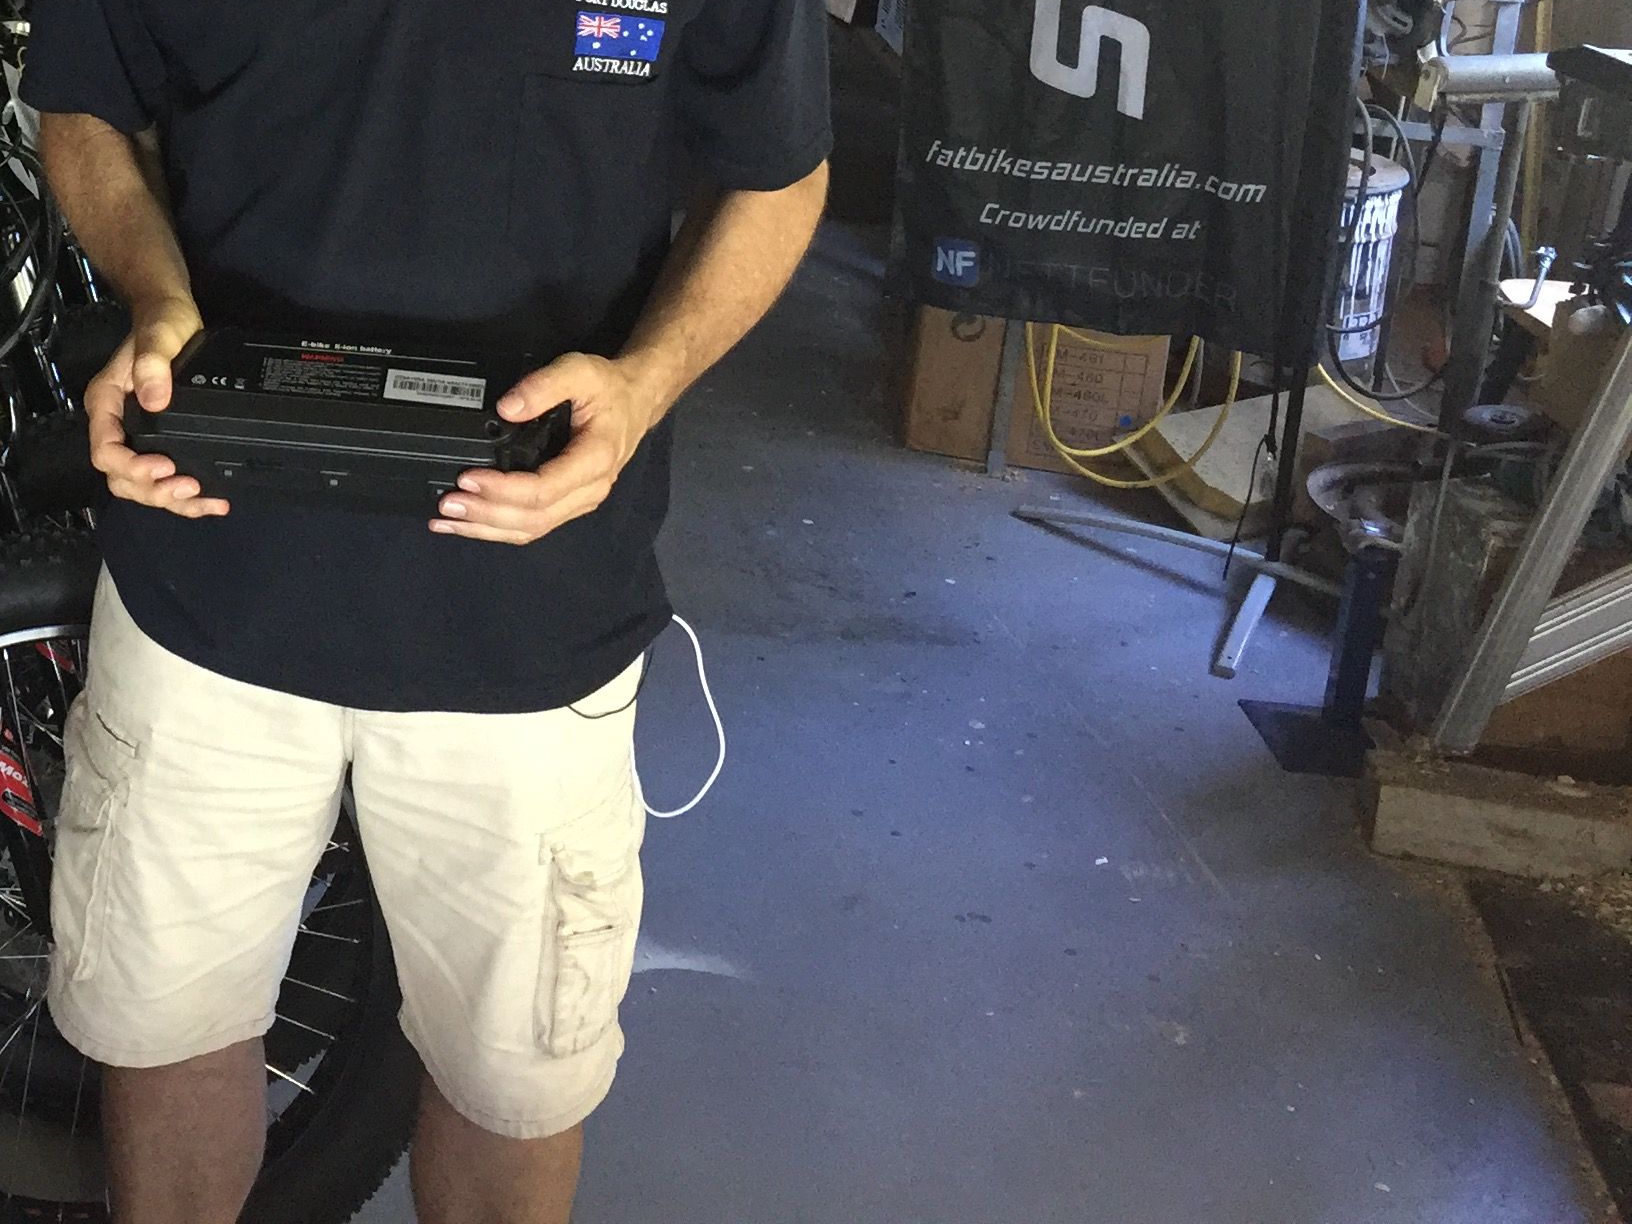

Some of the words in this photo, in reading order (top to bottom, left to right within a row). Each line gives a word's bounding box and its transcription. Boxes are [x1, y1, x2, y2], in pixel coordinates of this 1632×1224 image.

[572, 57, 651, 77] AUSTRALIA
[925, 139, 1267, 203] fatbikesaustralia.com
[979, 202, 1168, 239] Crowdfunded
[1171, 219, 1202, 240] at
[935, 245, 976, 277] NF
